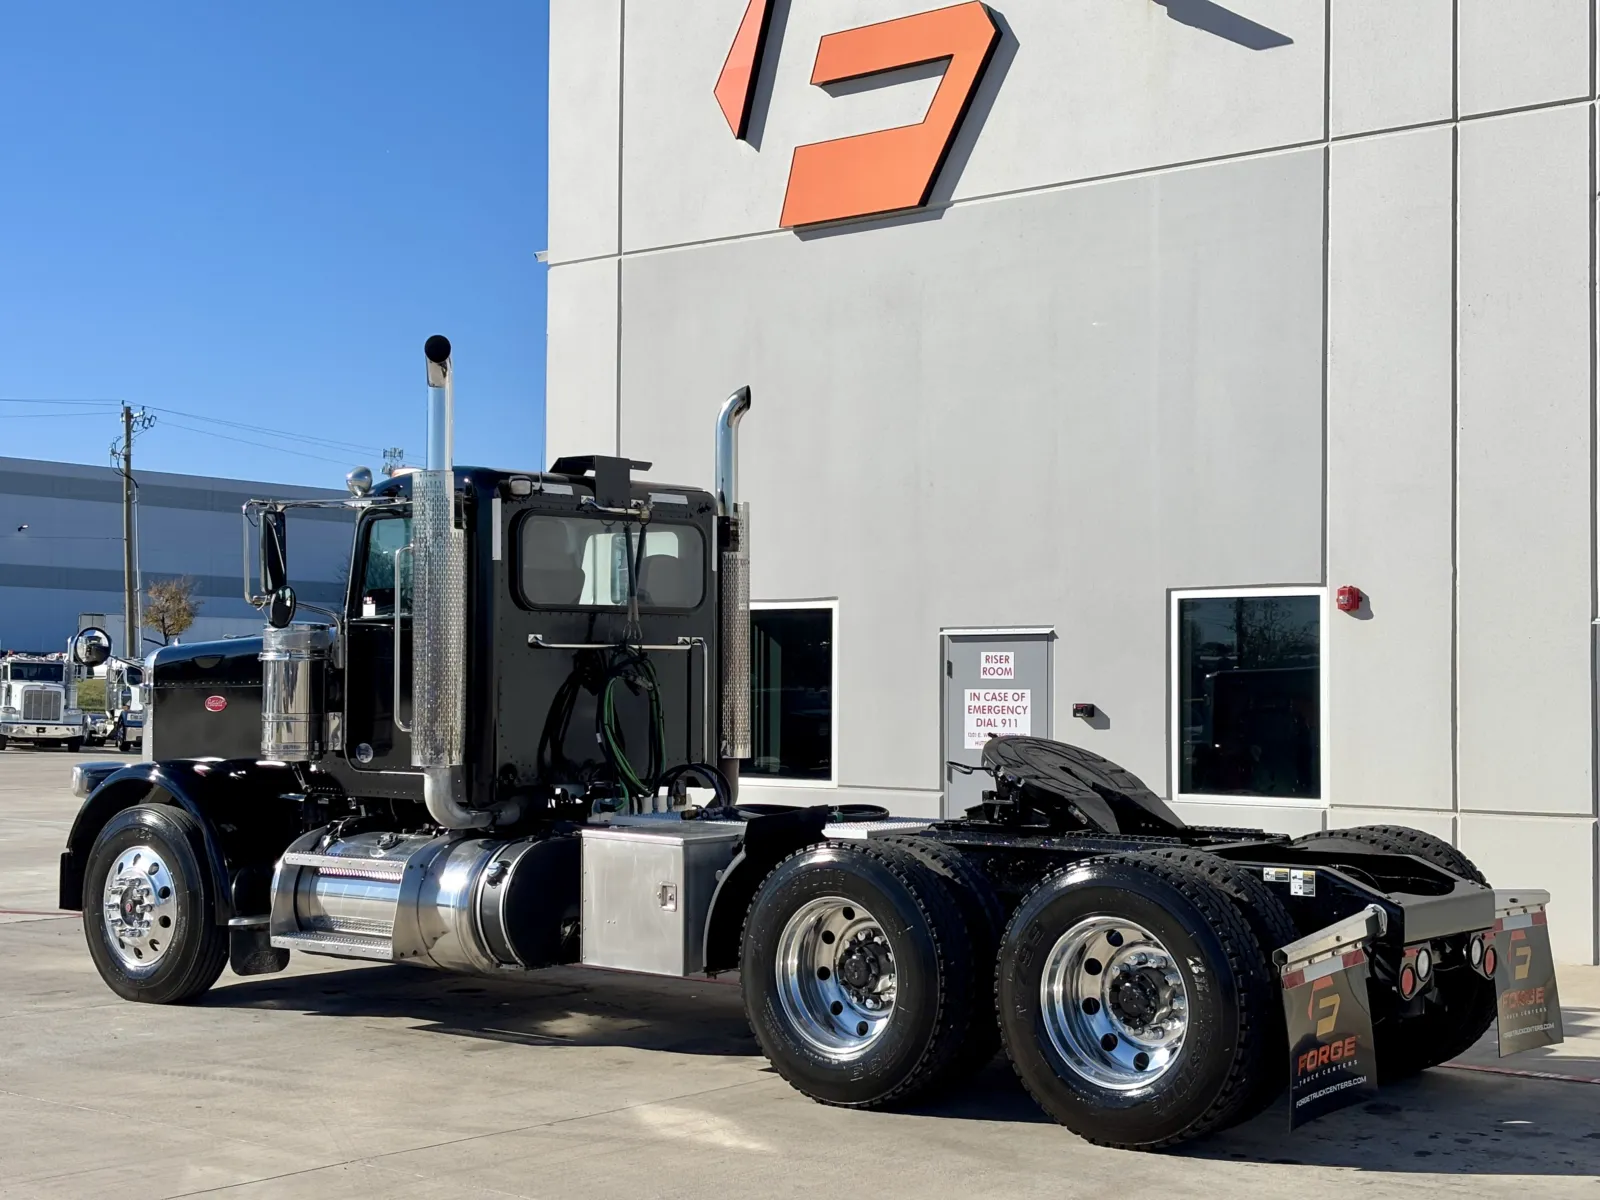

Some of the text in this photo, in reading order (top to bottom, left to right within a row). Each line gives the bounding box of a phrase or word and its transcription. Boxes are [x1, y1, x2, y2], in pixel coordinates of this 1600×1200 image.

[985, 655, 1010, 664] RISER
[982, 667, 1013, 676] ROOM
[970, 692, 1026, 702] IN CASE OF
[967, 705, 1028, 715] EMERGENCY
[976, 718, 1018, 728] DIAL 911
[1502, 986, 1545, 1009] FORGE
[1298, 1036, 1357, 1077] FORGE
[1299, 1059, 1358, 1087] TRUCK CENTERS
[1295, 1075, 1367, 1109] FORGETRUCKCENTERS.COM
